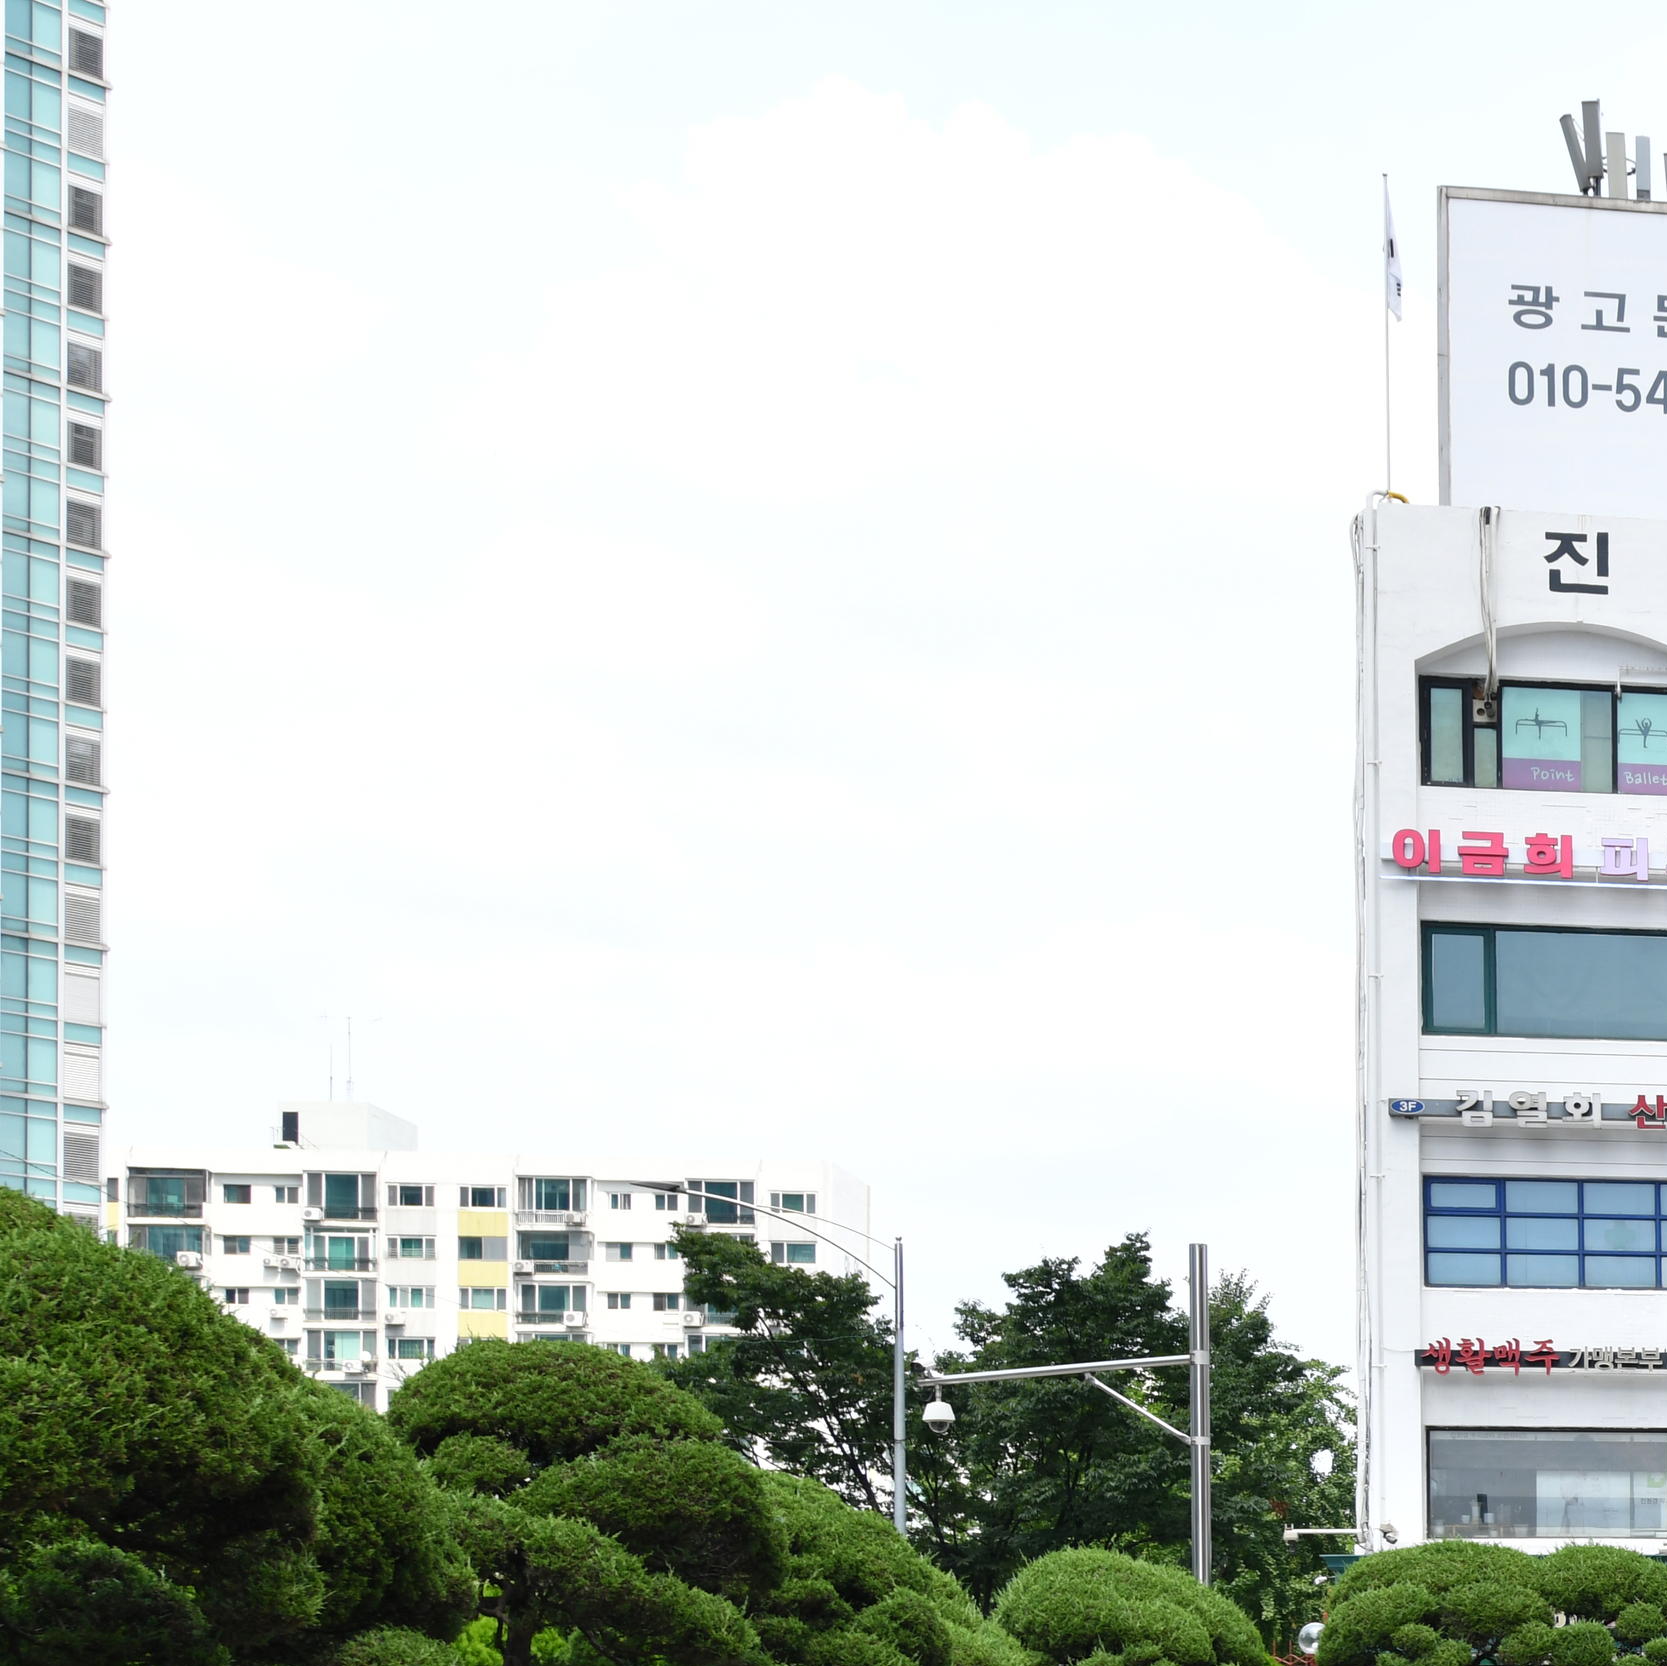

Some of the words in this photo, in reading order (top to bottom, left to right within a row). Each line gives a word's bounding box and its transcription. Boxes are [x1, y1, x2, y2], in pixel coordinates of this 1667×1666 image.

[1530, 765, 1576, 783] Point
[1391, 828, 1573, 880] 이금희
[1399, 1101, 1418, 1112] 3F
[1421, 1337, 1561, 1376] 생활맥주
[1568, 1346, 1664, 1372] 가맹본부
